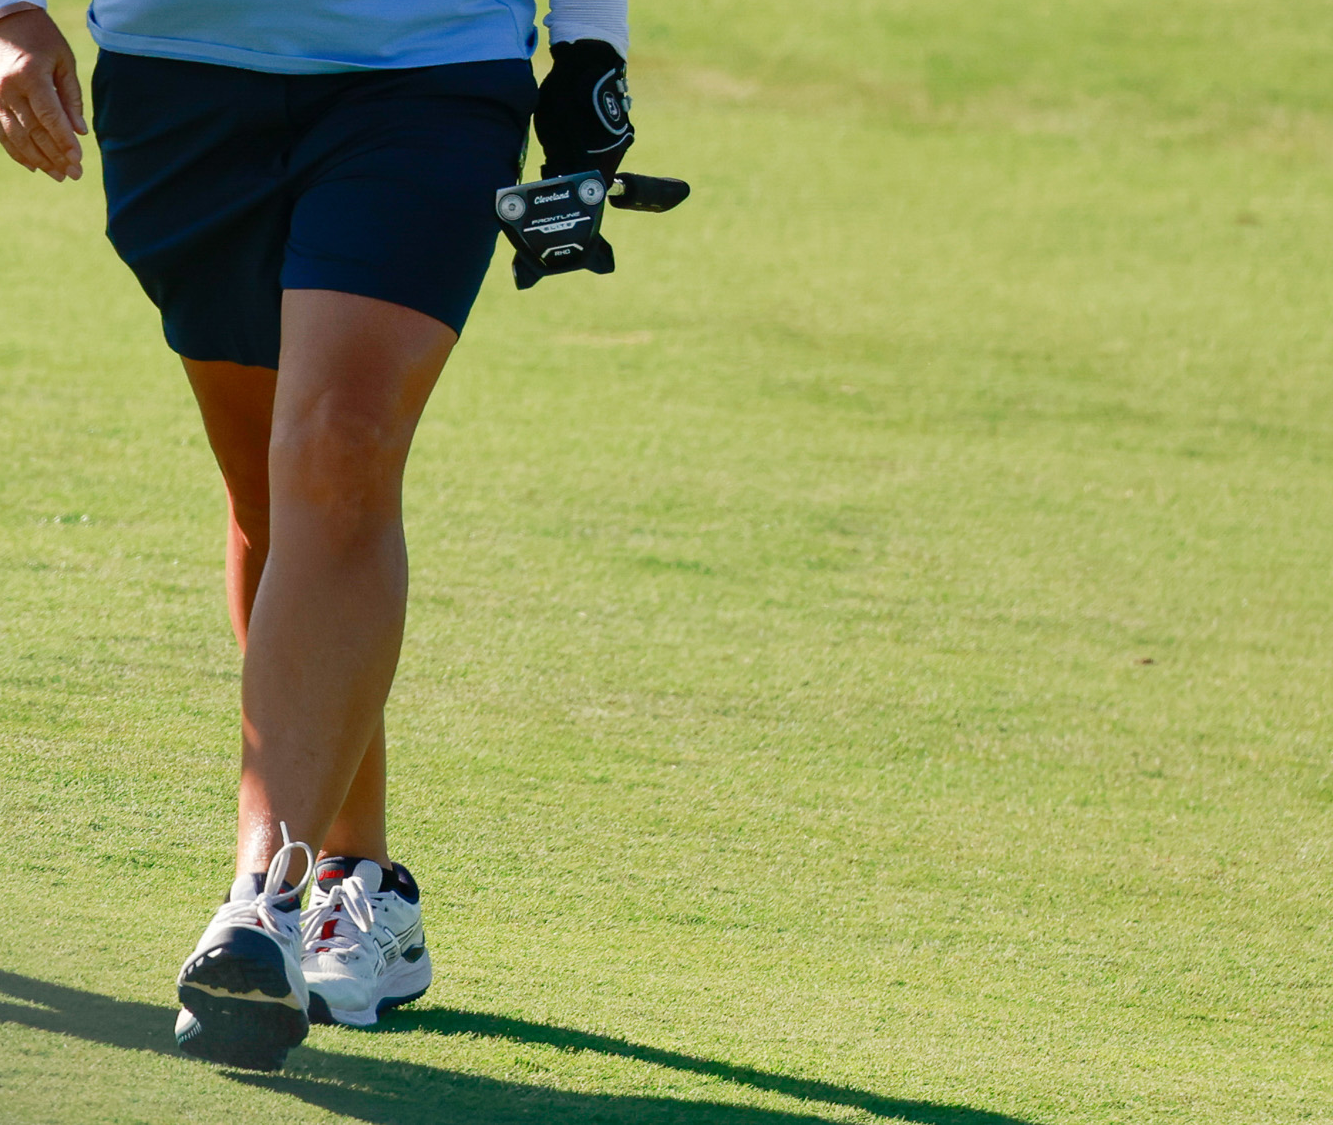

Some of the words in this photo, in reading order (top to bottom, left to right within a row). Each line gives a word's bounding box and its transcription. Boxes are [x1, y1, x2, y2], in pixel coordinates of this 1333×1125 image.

[534, 189, 570, 205] Cleveland
[531, 211, 581, 225] FRONTLINE
[543, 222, 572, 231] ELITE
